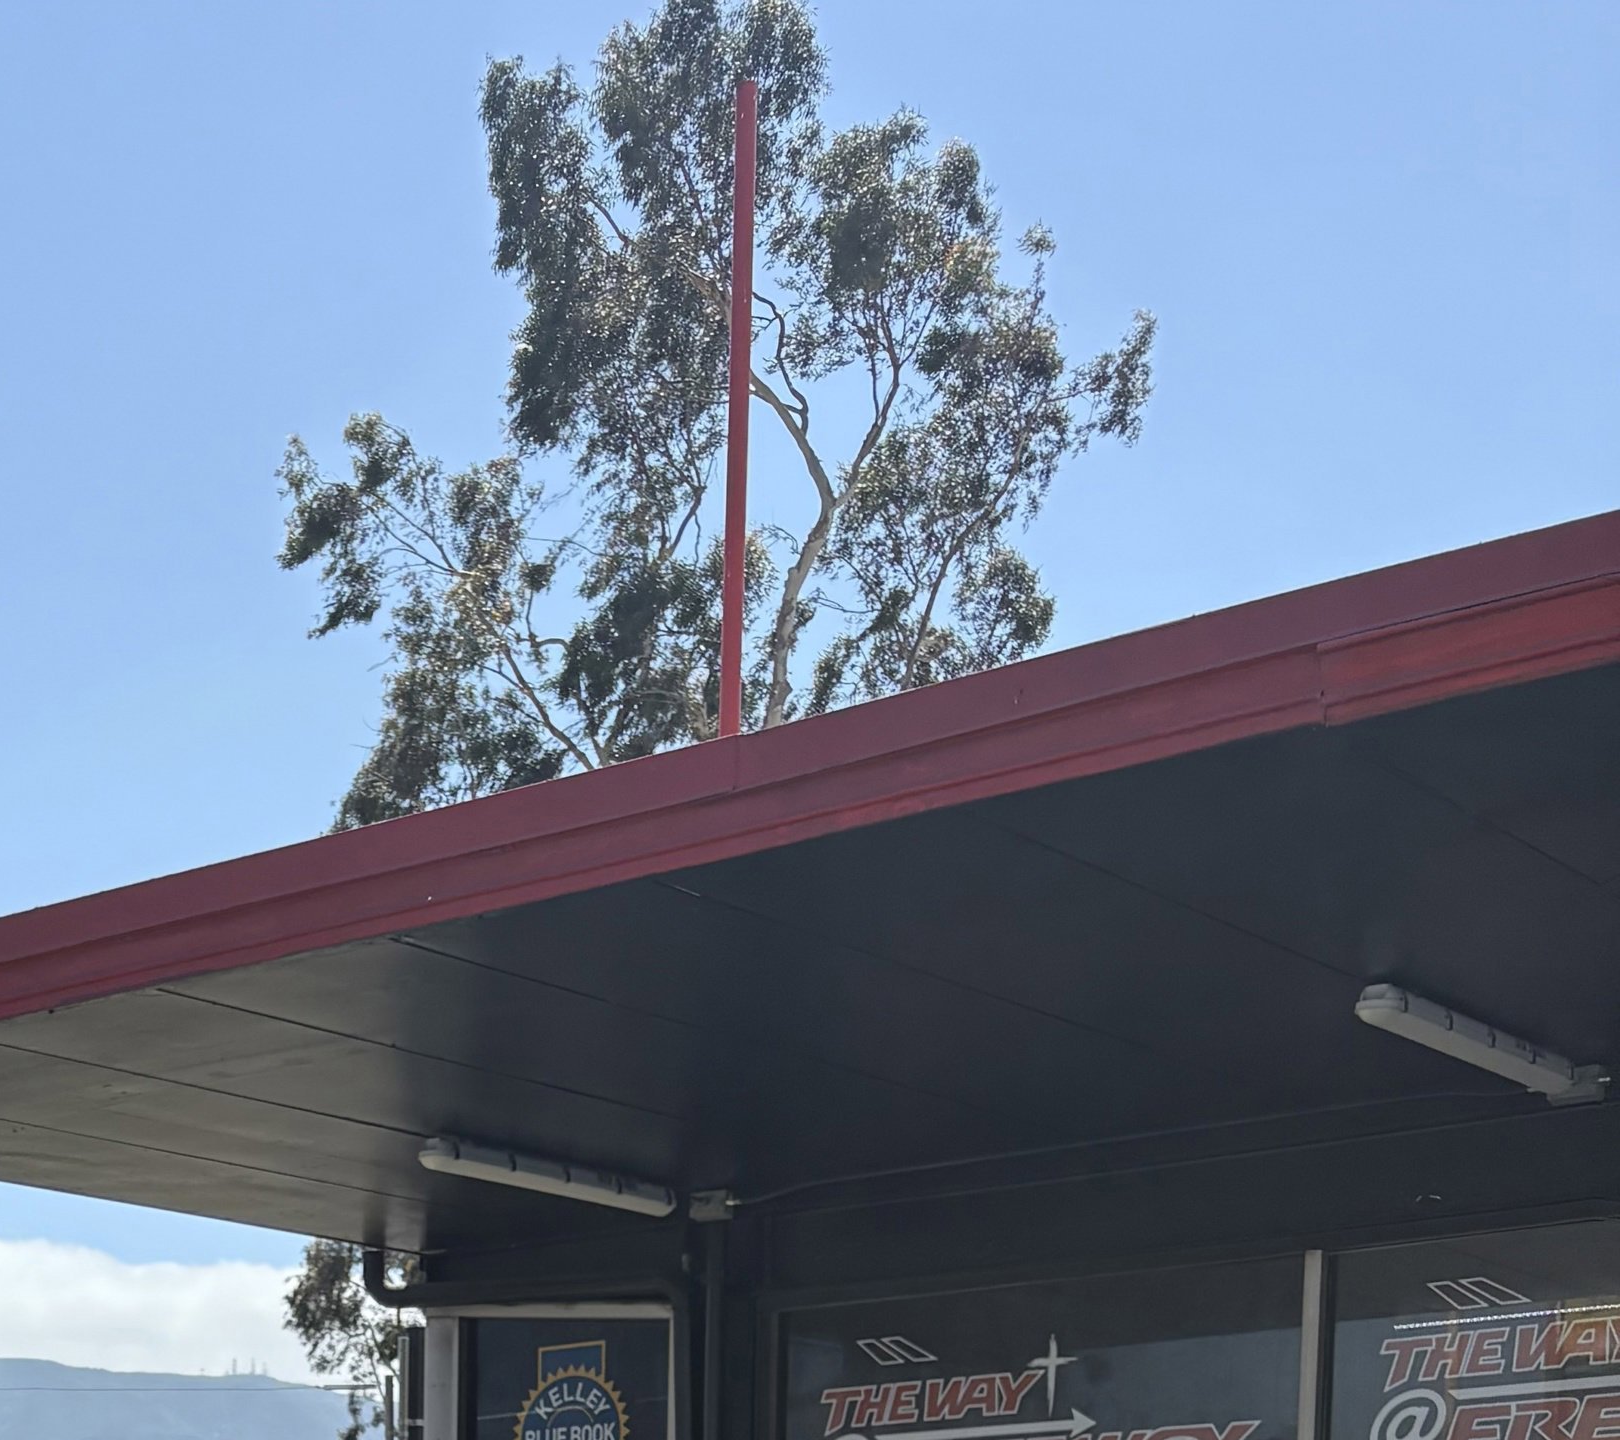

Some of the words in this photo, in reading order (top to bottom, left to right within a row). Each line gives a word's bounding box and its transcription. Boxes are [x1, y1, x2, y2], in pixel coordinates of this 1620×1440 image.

[1380, 1327, 1510, 1393] THE
[1512, 1315, 1620, 1373] WA
[534, 1382, 611, 1420] KELLEY
[820, 1379, 922, 1437] THE
[923, 1369, 1046, 1422] WAY
